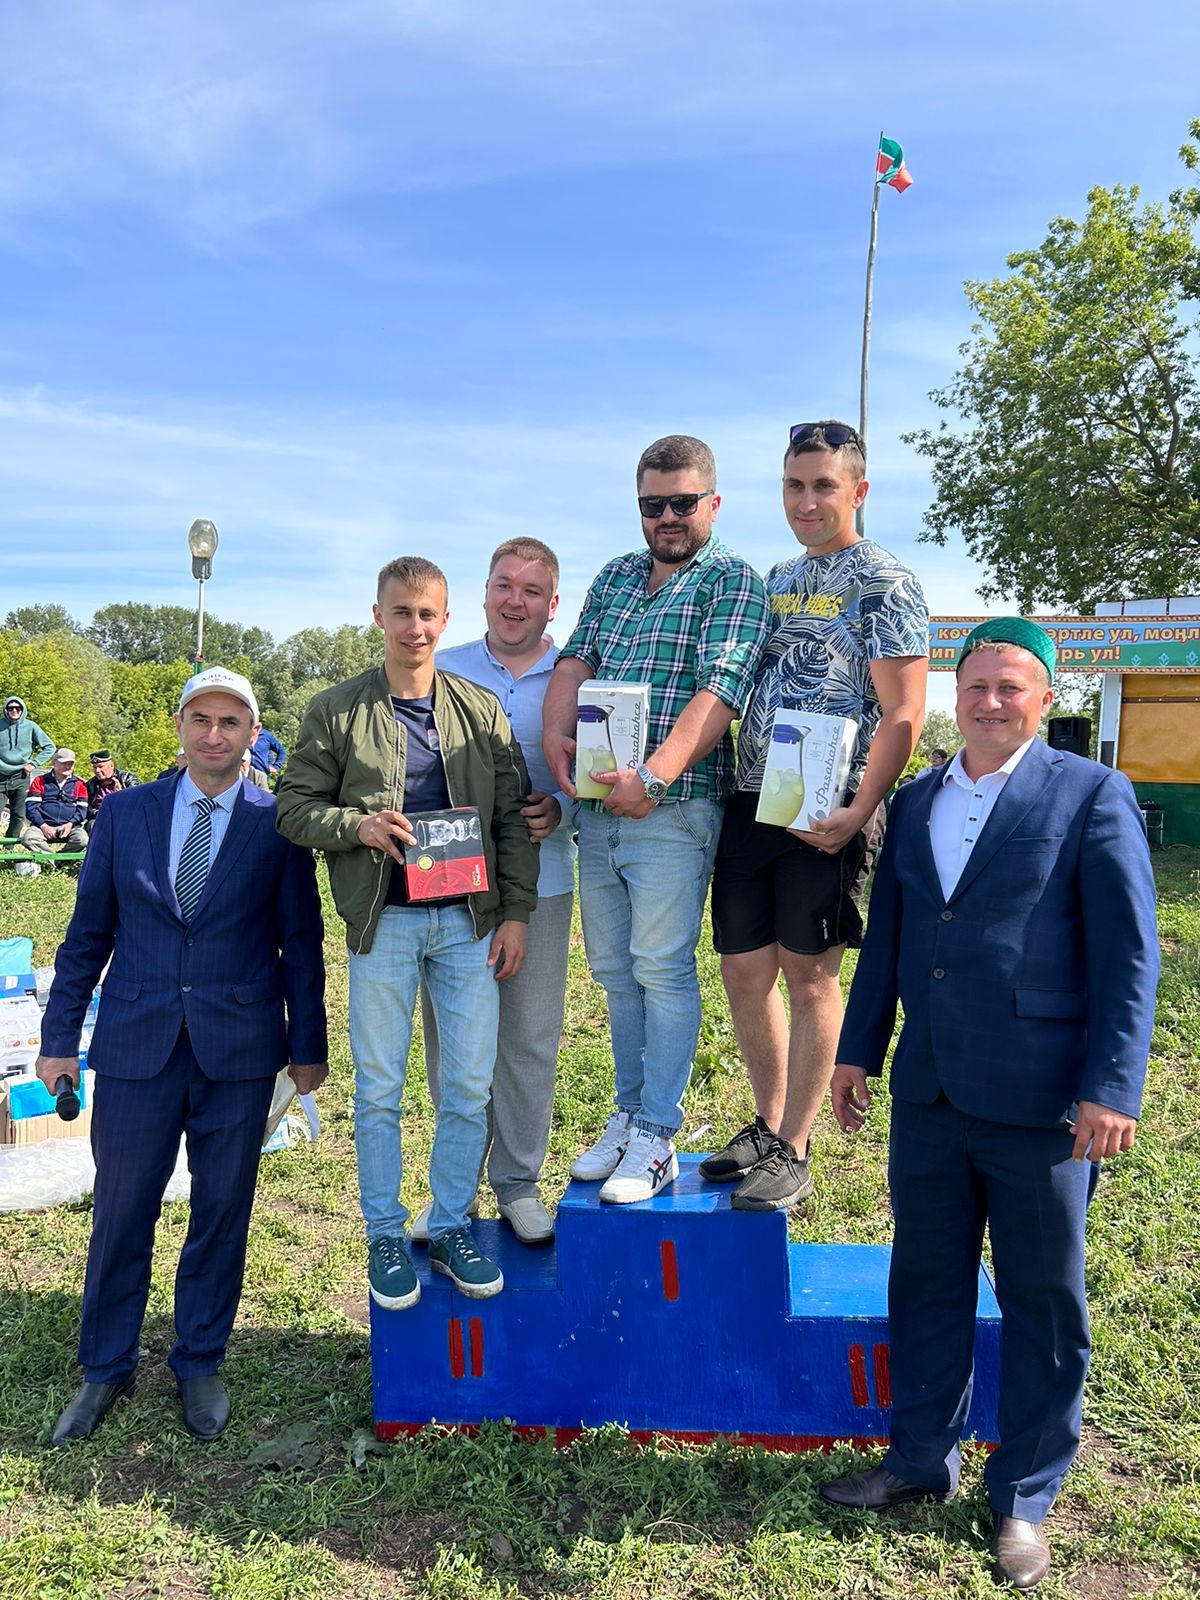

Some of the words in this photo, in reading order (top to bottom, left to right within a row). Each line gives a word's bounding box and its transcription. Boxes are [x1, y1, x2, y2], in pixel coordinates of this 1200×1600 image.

[1044, 627, 1105, 644] әртле
[1108, 627, 1140, 644] ул,
[929, 647, 956, 661] ип
[1089, 644, 1120, 664] ул!
